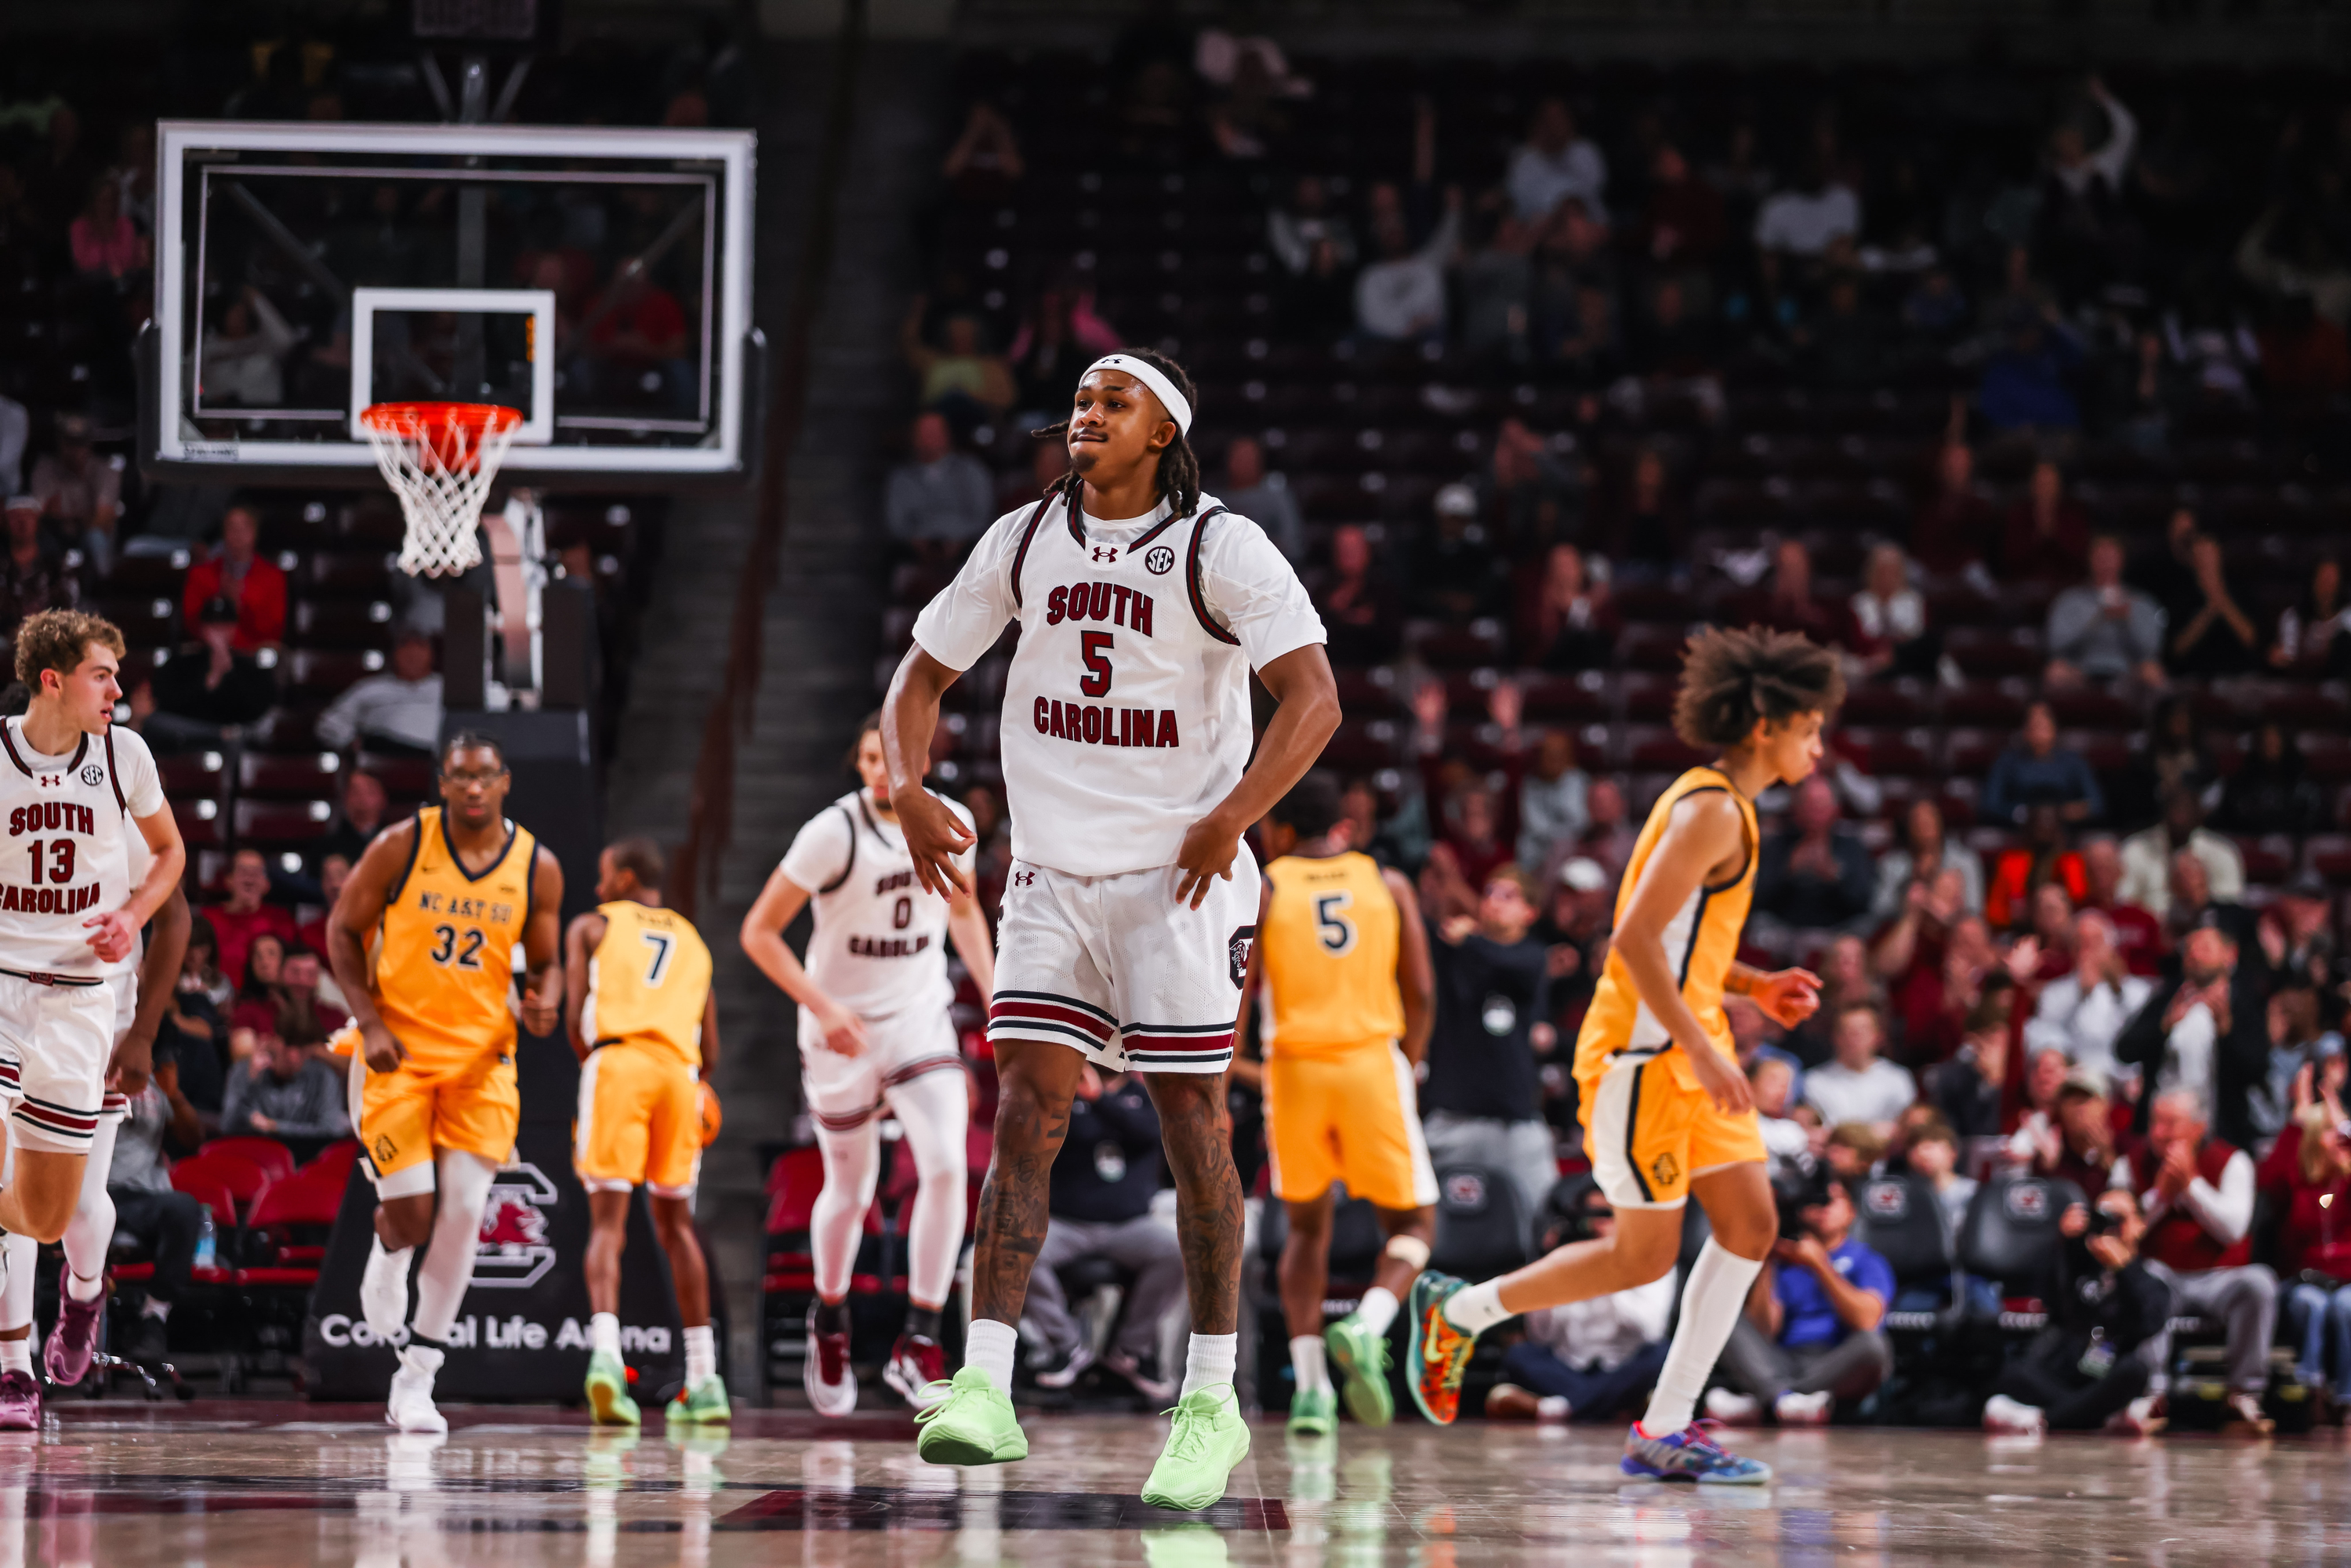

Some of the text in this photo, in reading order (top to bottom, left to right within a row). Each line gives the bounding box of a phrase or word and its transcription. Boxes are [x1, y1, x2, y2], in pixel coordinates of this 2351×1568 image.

[1147, 548, 1173, 573] SEC
[1047, 582, 1154, 637] SOUTH
[1079, 630, 1114, 698] 5
[1034, 695, 1179, 747] CAROLINA
[82, 765, 103, 785] SEC
[9, 802, 94, 837] SOUTH
[27, 838, 76, 885] 13
[0, 881, 100, 914] AROLINA
[894, 896, 911, 928] 0
[1313, 892, 1353, 954] 5
[430, 924, 487, 970] 32
[642, 931, 674, 985] 7
[320, 1313, 672, 1353] Cooal Life Arna
